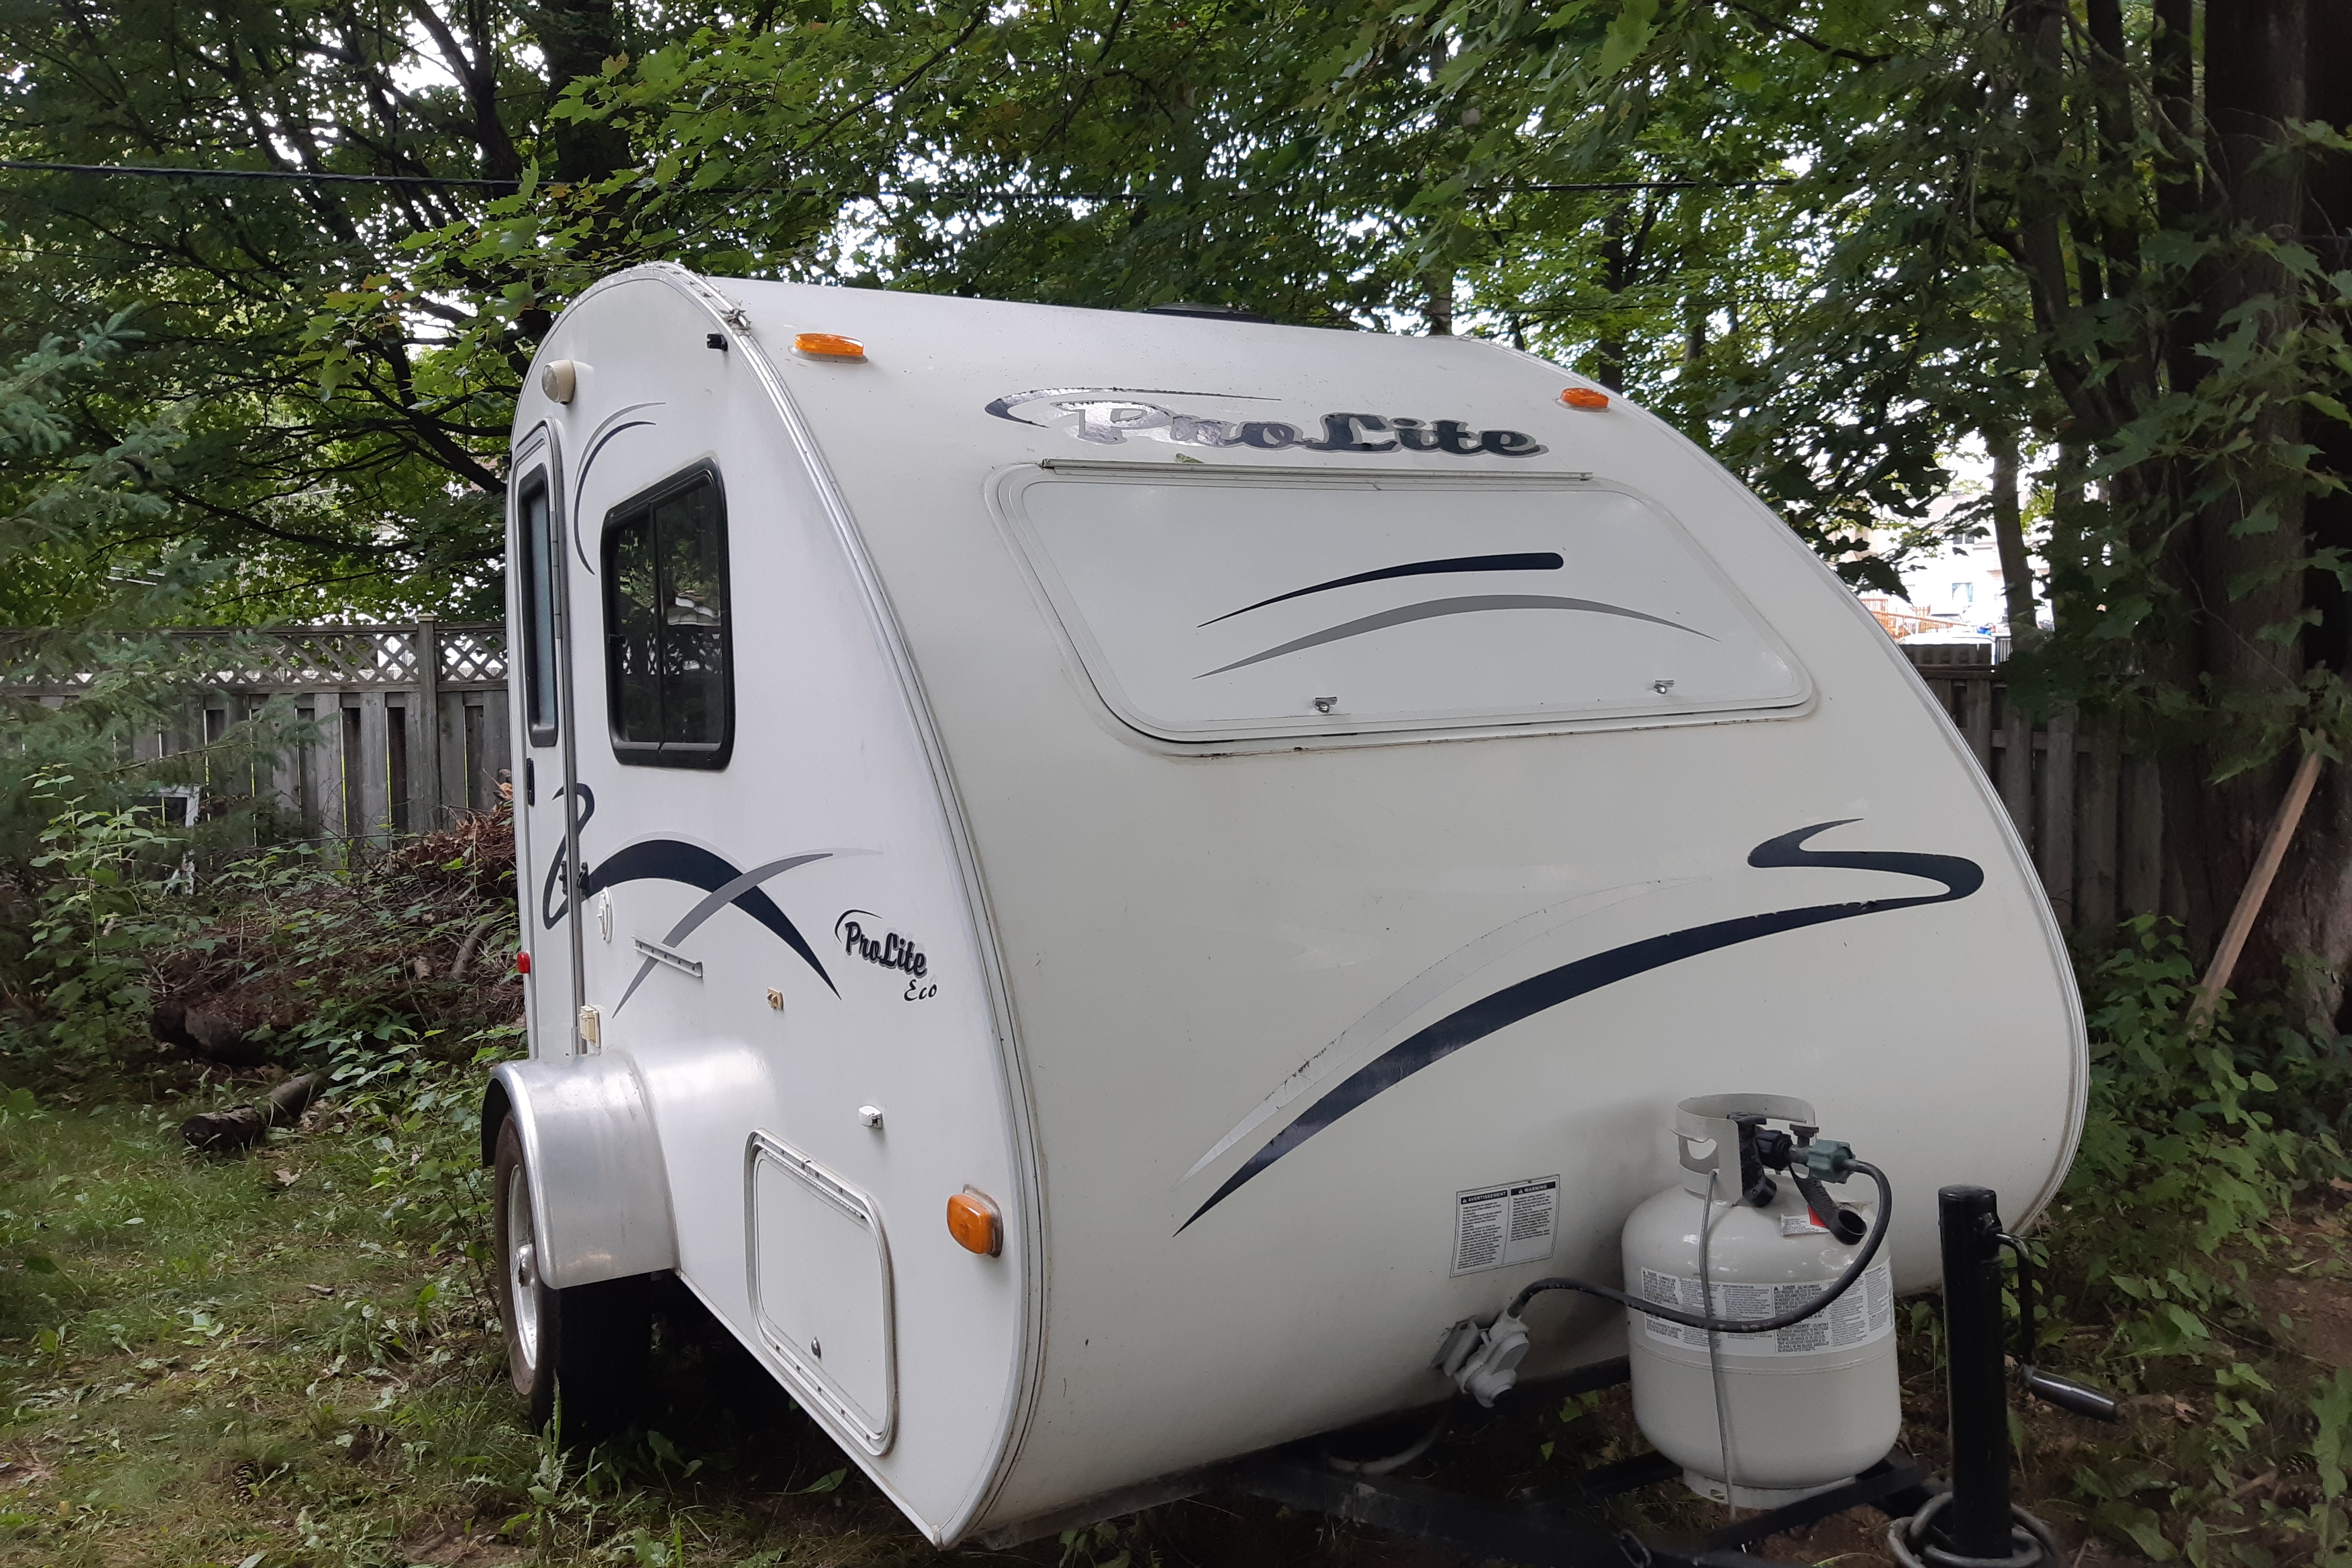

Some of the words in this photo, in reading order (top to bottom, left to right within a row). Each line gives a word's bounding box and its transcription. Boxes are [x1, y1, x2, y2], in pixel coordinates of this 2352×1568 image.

[1050, 400, 1549, 458] ProLite
[845, 921, 928, 979] ProLite
[903, 978, 938, 1001] Eco
[1468, 1191, 1506, 1202] AVERTISSEMENT
[1524, 1185, 1547, 1193] WARNING
